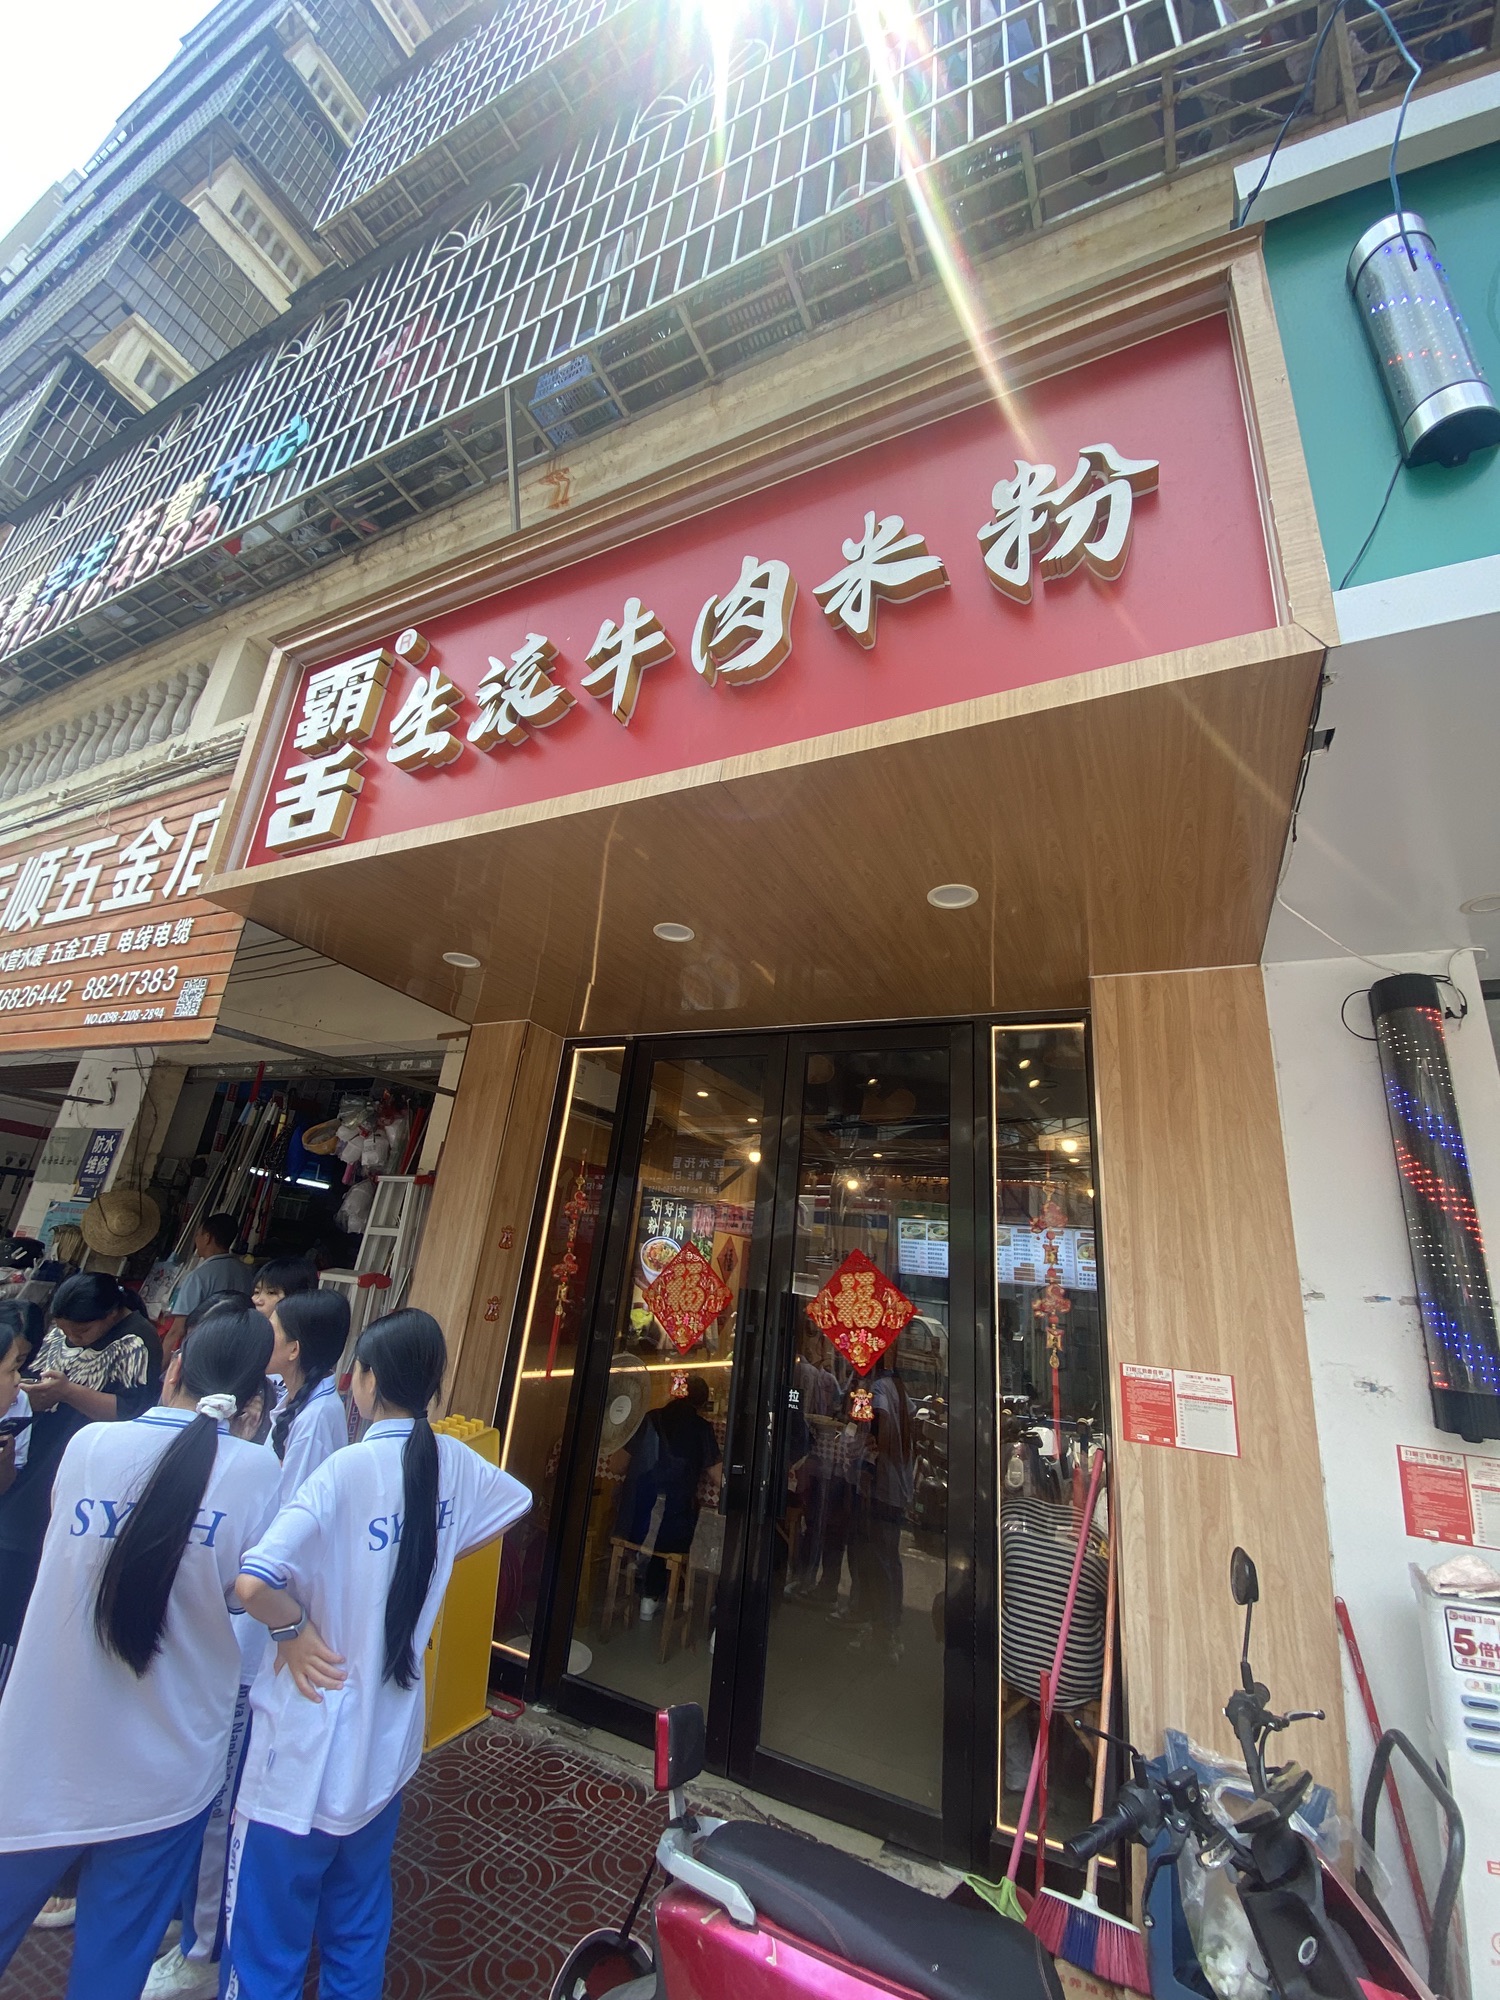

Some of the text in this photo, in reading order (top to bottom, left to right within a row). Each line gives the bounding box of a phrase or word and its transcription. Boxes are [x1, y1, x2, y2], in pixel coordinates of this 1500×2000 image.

[265, 647, 392, 852] 霸舌
[47, 932, 111, 965] 五金工具
[117, 917, 195, 954] 电线电缆
[81, 965, 180, 1001] 88217383
[92, 1135, 116, 1153] 防水
[84, 1156, 110, 1175] 维修
[666, 1262, 705, 1313] 福
[834, 1271, 884, 1330] 福
[788, 1389, 800, 1403] 拉
